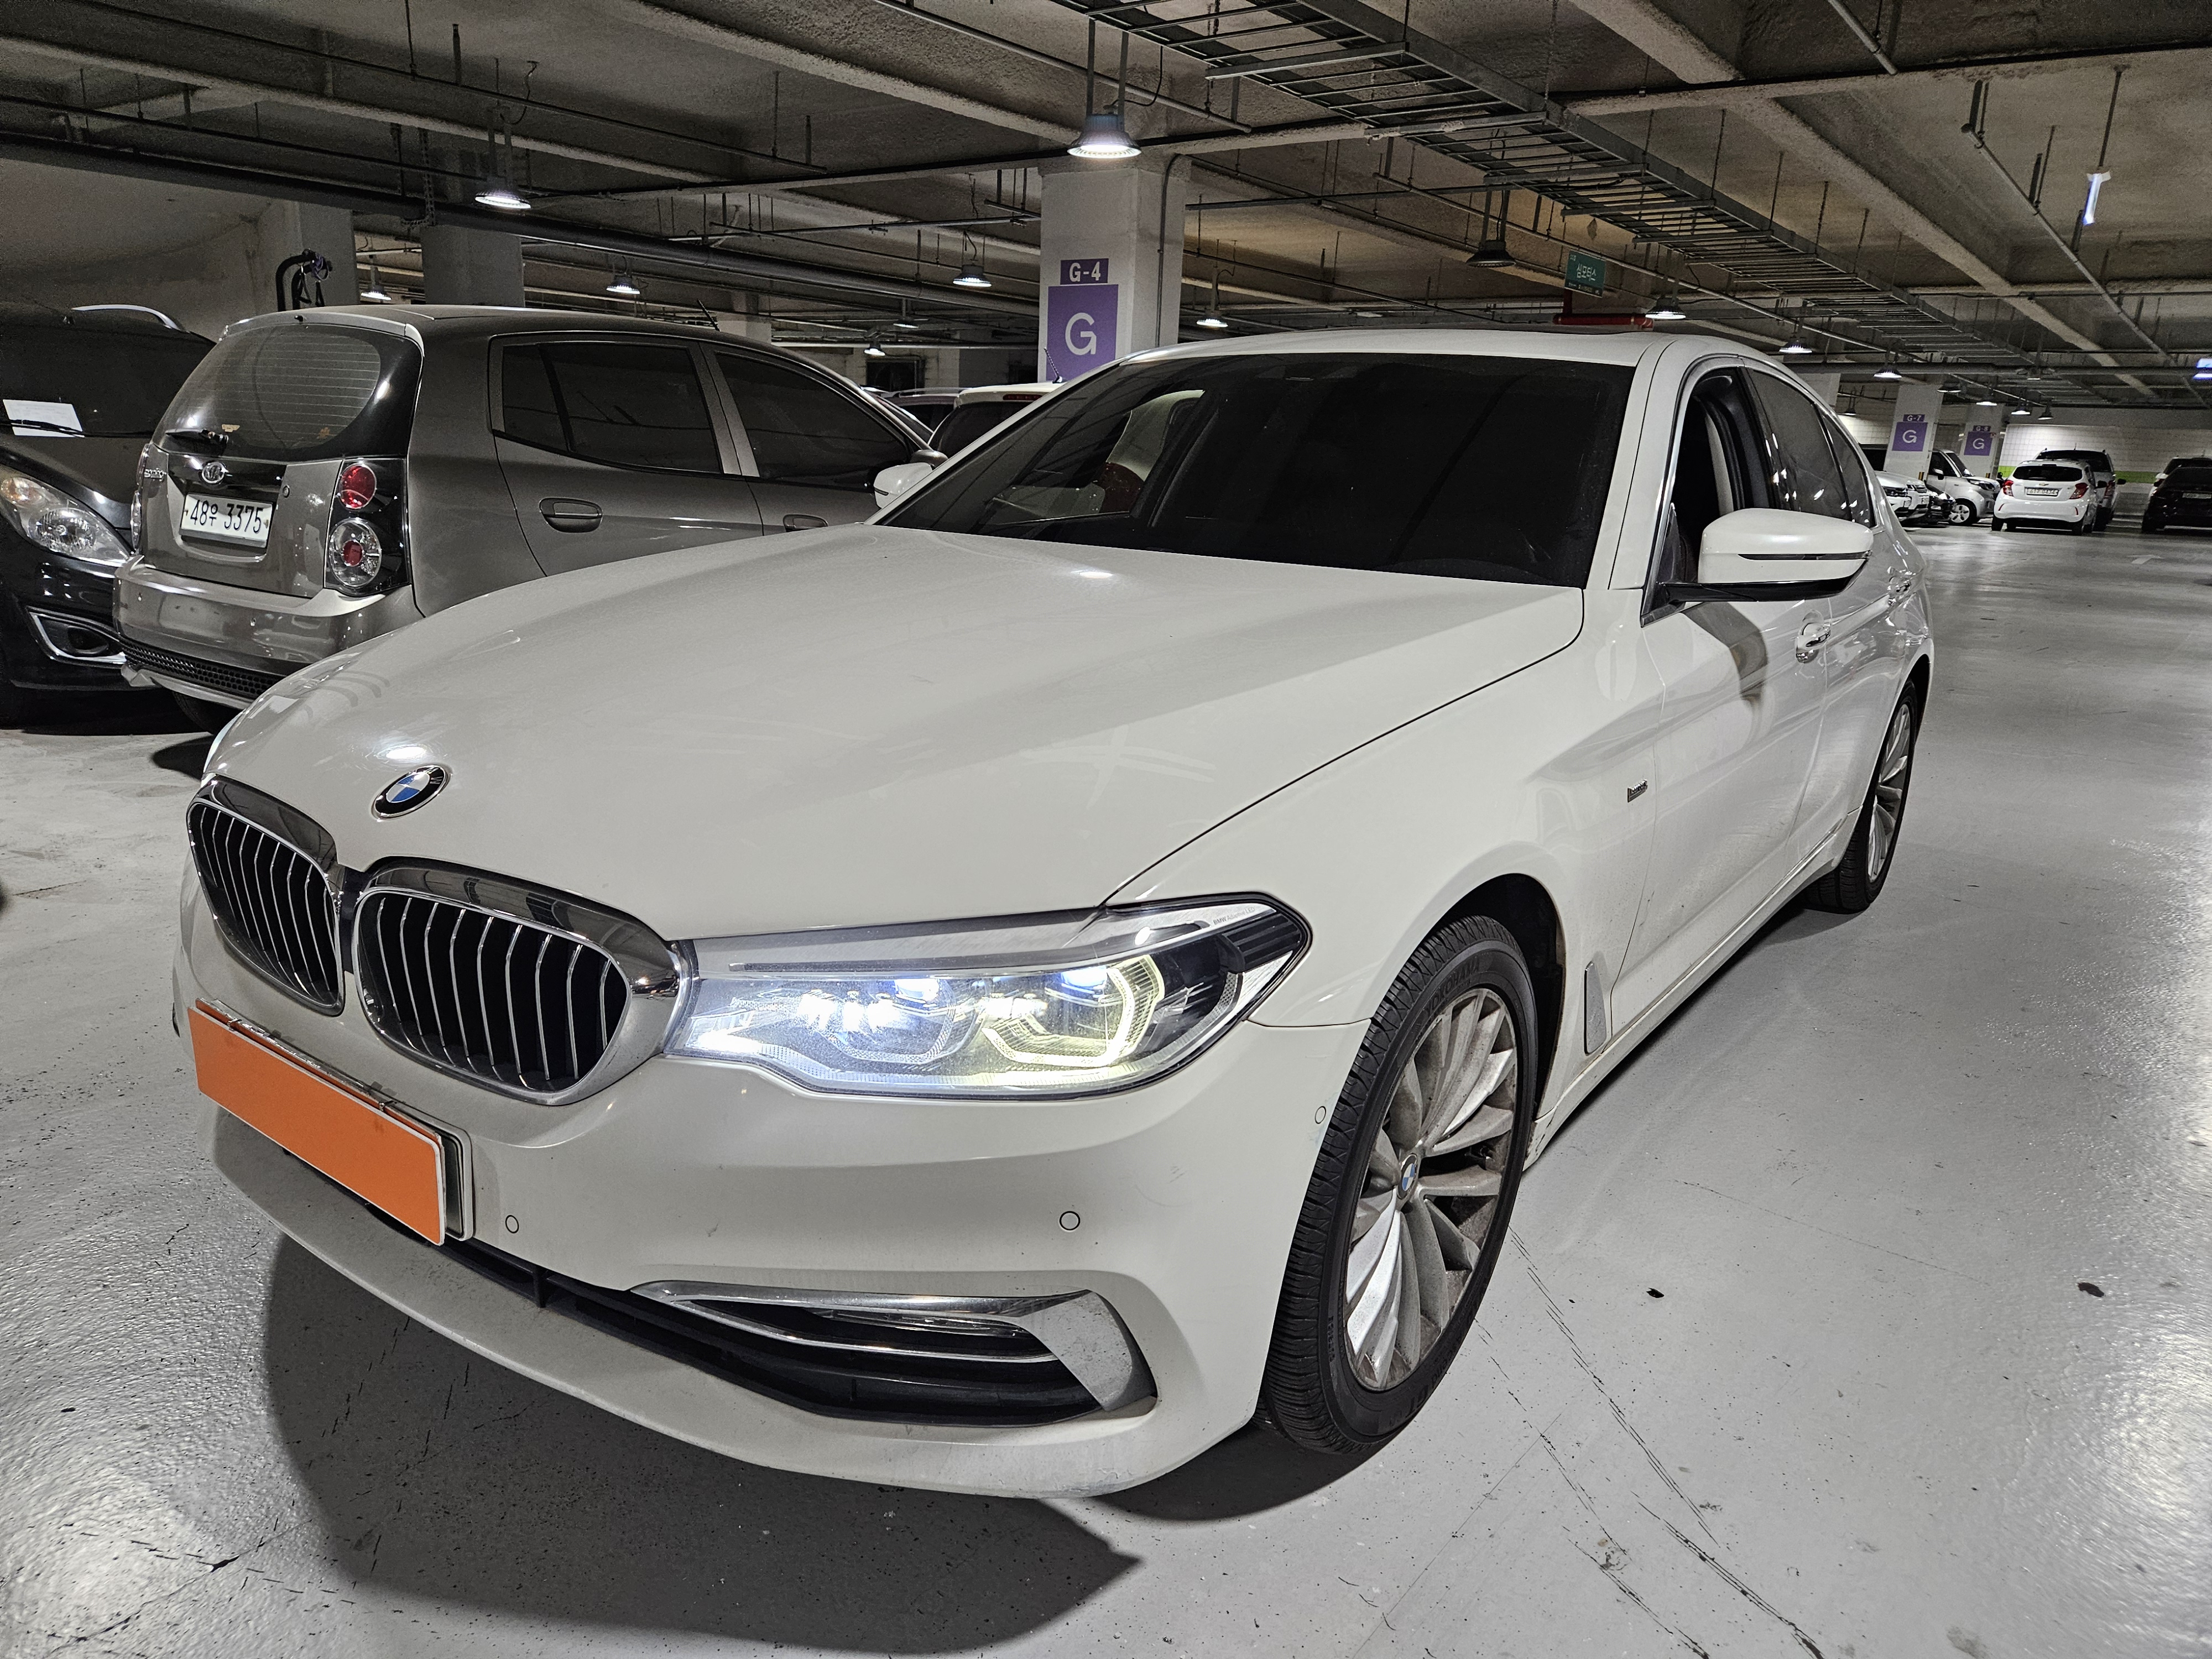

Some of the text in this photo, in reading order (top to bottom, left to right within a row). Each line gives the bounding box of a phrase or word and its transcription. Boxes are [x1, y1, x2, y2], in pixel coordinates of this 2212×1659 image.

[1070, 262, 1101, 282] G-4
[1065, 312, 1097, 356] G
[1902, 429, 1917, 444] G
[1973, 438, 1985, 450] G
[190, 499, 264, 534] 48우 3375
[1213, 916, 1227, 925] BMW
[1424, 956, 1480, 1018] YOKOHAMA
